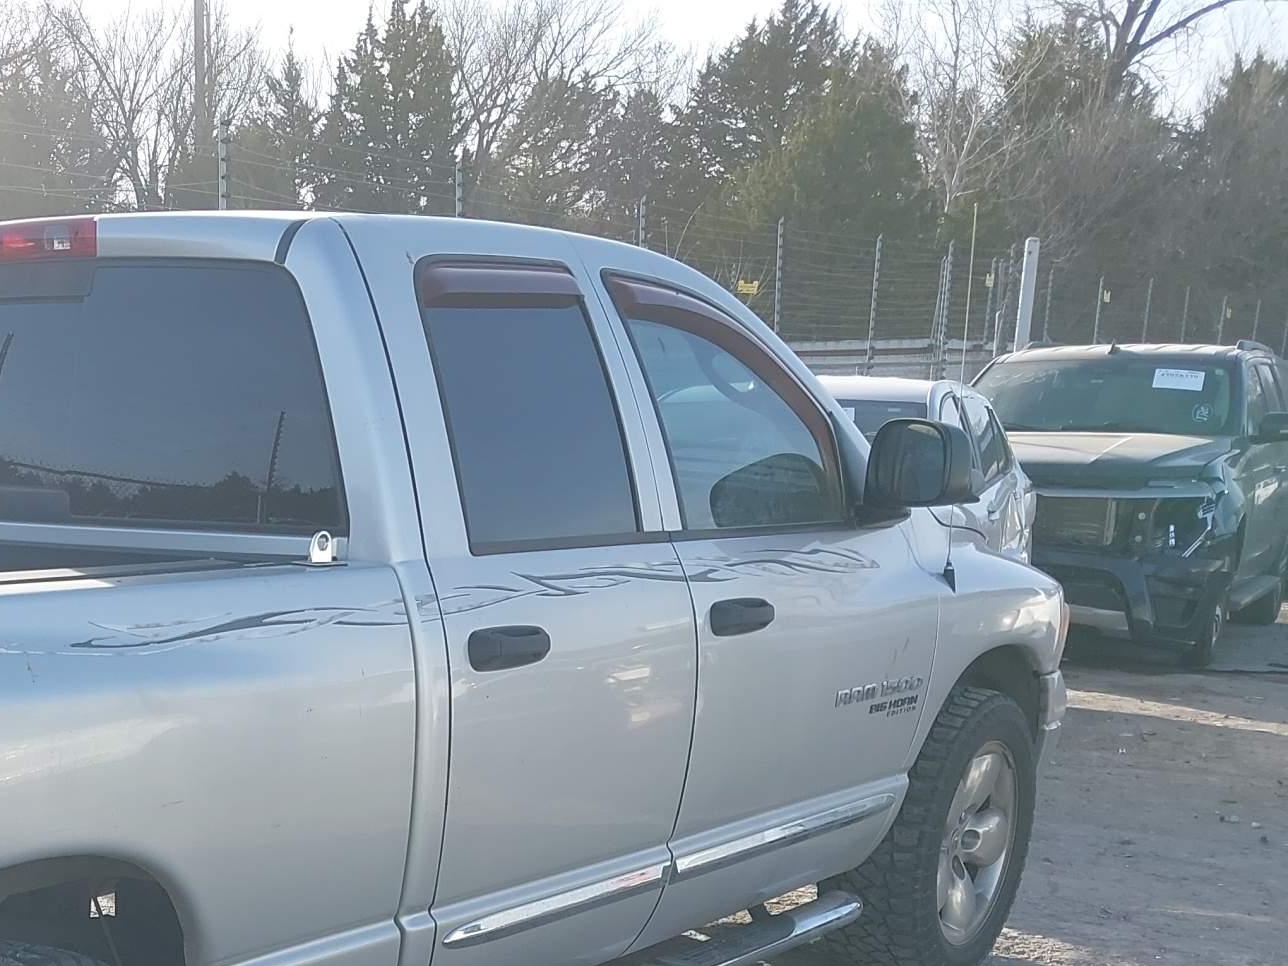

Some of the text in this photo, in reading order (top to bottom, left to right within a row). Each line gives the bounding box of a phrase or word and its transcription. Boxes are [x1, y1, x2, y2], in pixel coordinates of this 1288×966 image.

[869, 694, 919, 714] BIG HORN
[886, 706, 917, 717] EDITION
